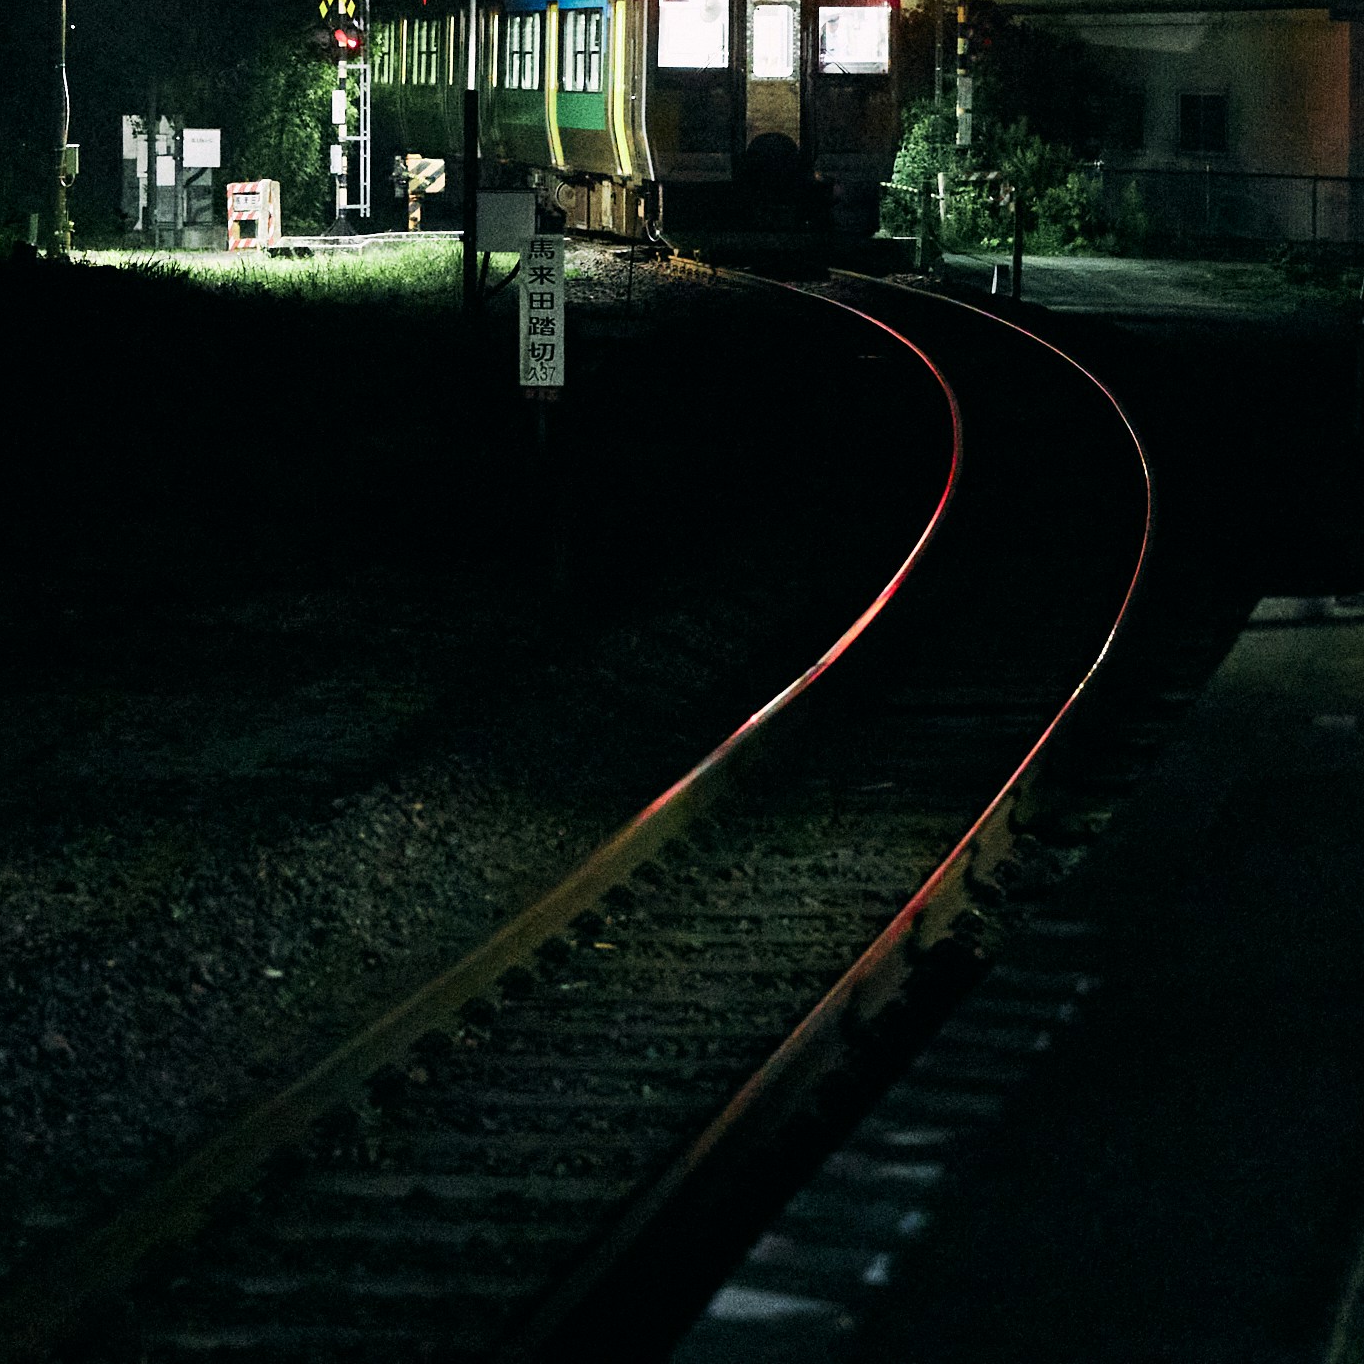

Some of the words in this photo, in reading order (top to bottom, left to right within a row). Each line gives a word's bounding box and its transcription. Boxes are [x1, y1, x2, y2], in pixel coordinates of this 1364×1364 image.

[528, 238, 555, 362] 馬来田踏切
